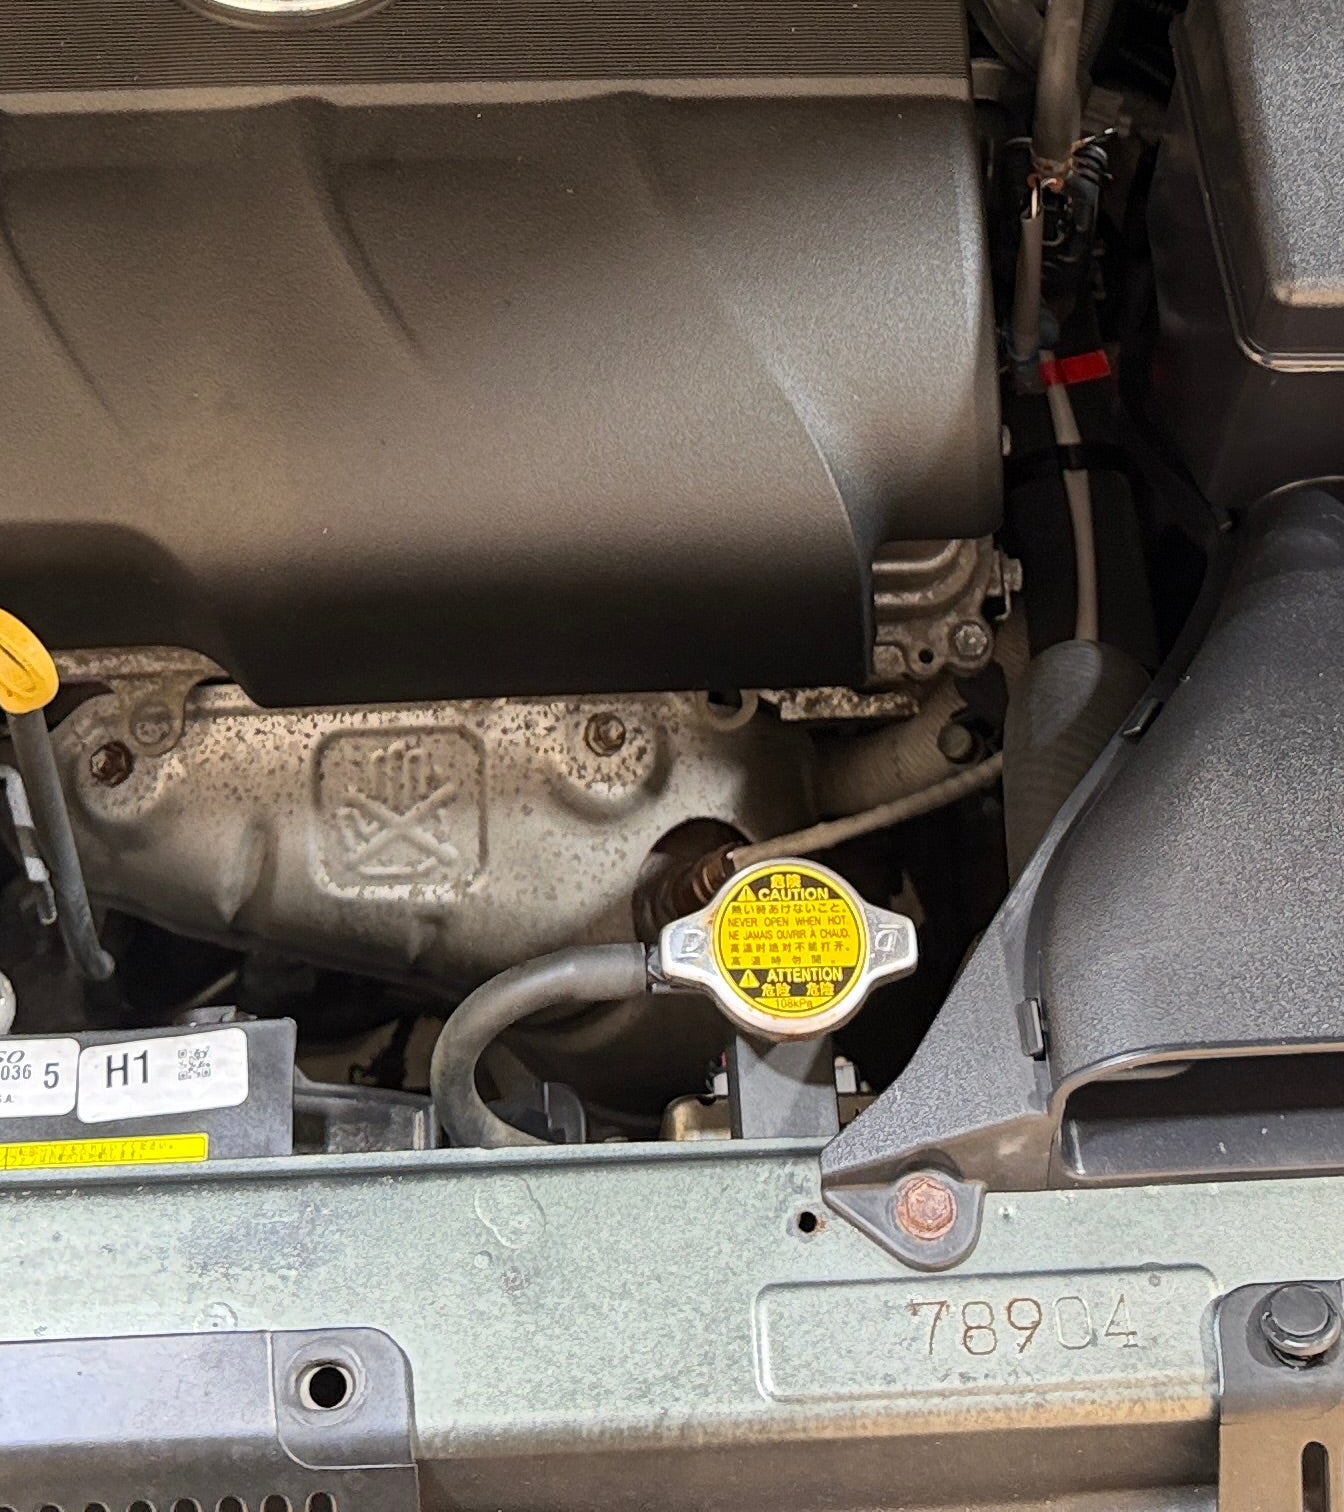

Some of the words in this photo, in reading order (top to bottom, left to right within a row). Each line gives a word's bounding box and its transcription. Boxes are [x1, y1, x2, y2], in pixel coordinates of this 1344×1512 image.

[770, 873, 802, 889] 危険
[758, 886, 830, 902] CAUTION
[727, 917, 758, 928] NEVER
[764, 916, 790, 928] OPEN
[795, 915, 822, 927] WHEN
[728, 929, 739, 940] NE
[742, 928, 773, 940] JAMAIS
[776, 928, 806, 939] OUVRIR
[809, 926, 817, 938] À
[766, 966, 844, 983] ATTENTION
[774, 998, 813, 1009] 108kPa
[43, 1062, 60, 1089] 5
[106, 1049, 149, 1089] H1
[907, 1292, 1139, 1356] 78904
